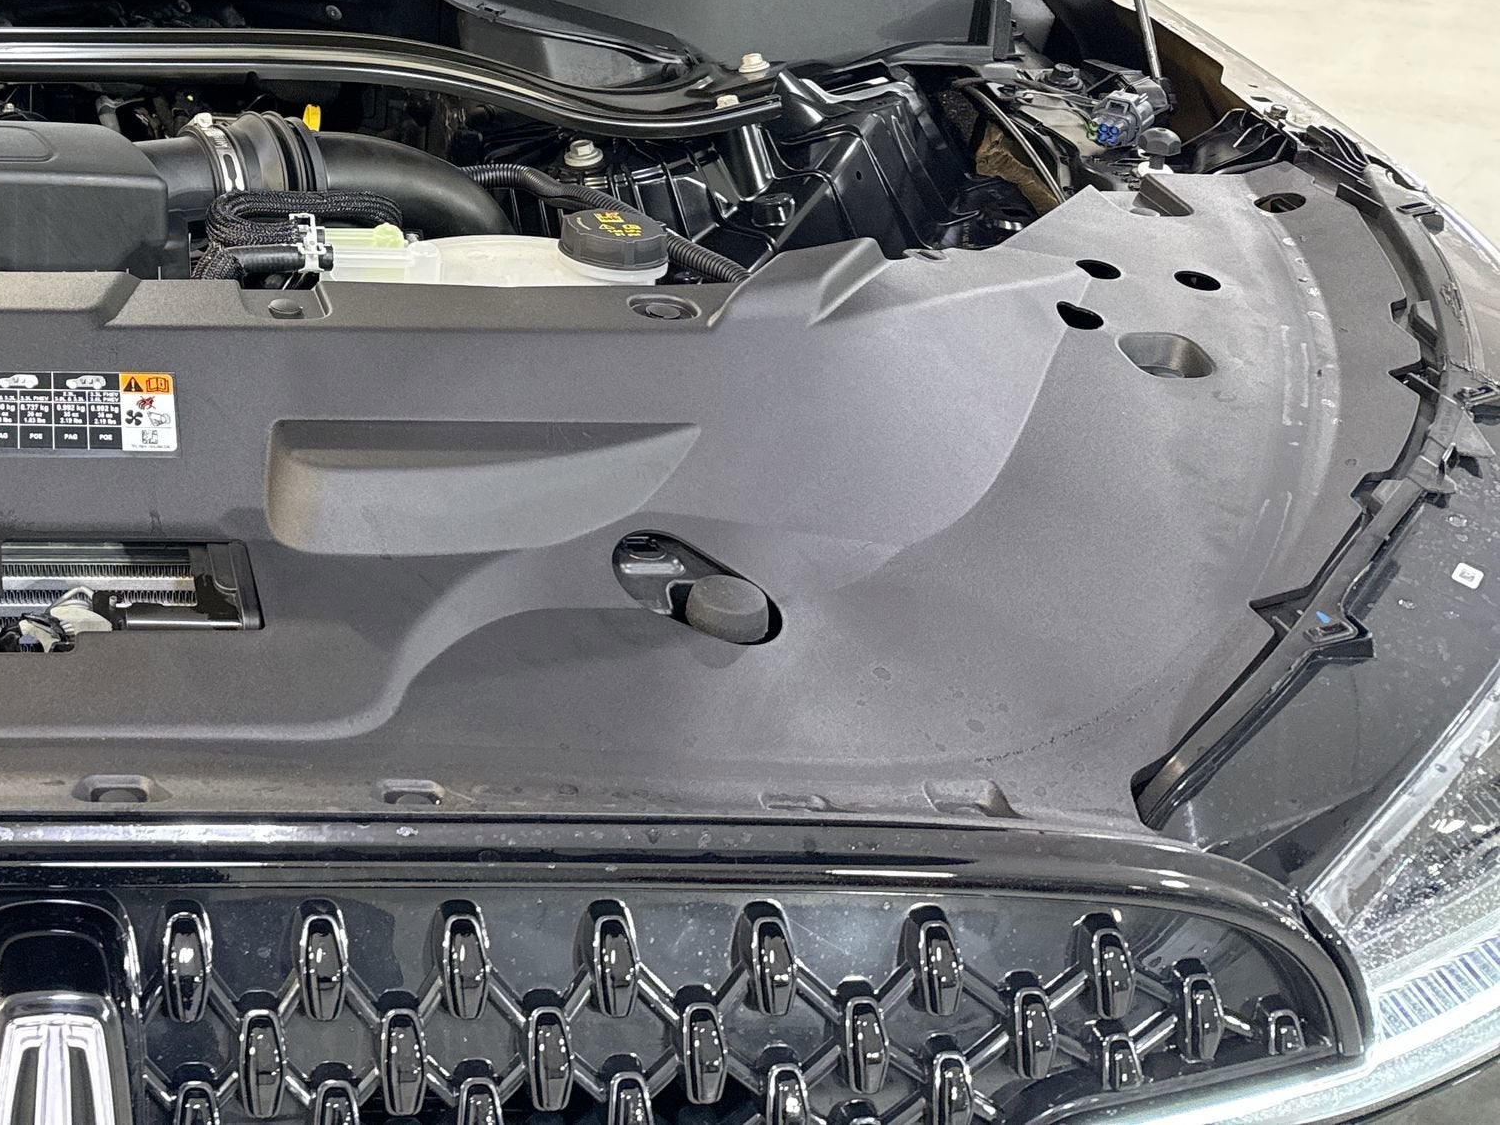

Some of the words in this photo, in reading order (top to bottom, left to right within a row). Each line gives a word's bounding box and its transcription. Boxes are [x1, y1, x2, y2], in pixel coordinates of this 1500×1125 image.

[6, 404, 16, 412] kg
[40, 404, 49, 412] kg
[76, 405, 85, 413] kg
[110, 405, 119, 413] kg
